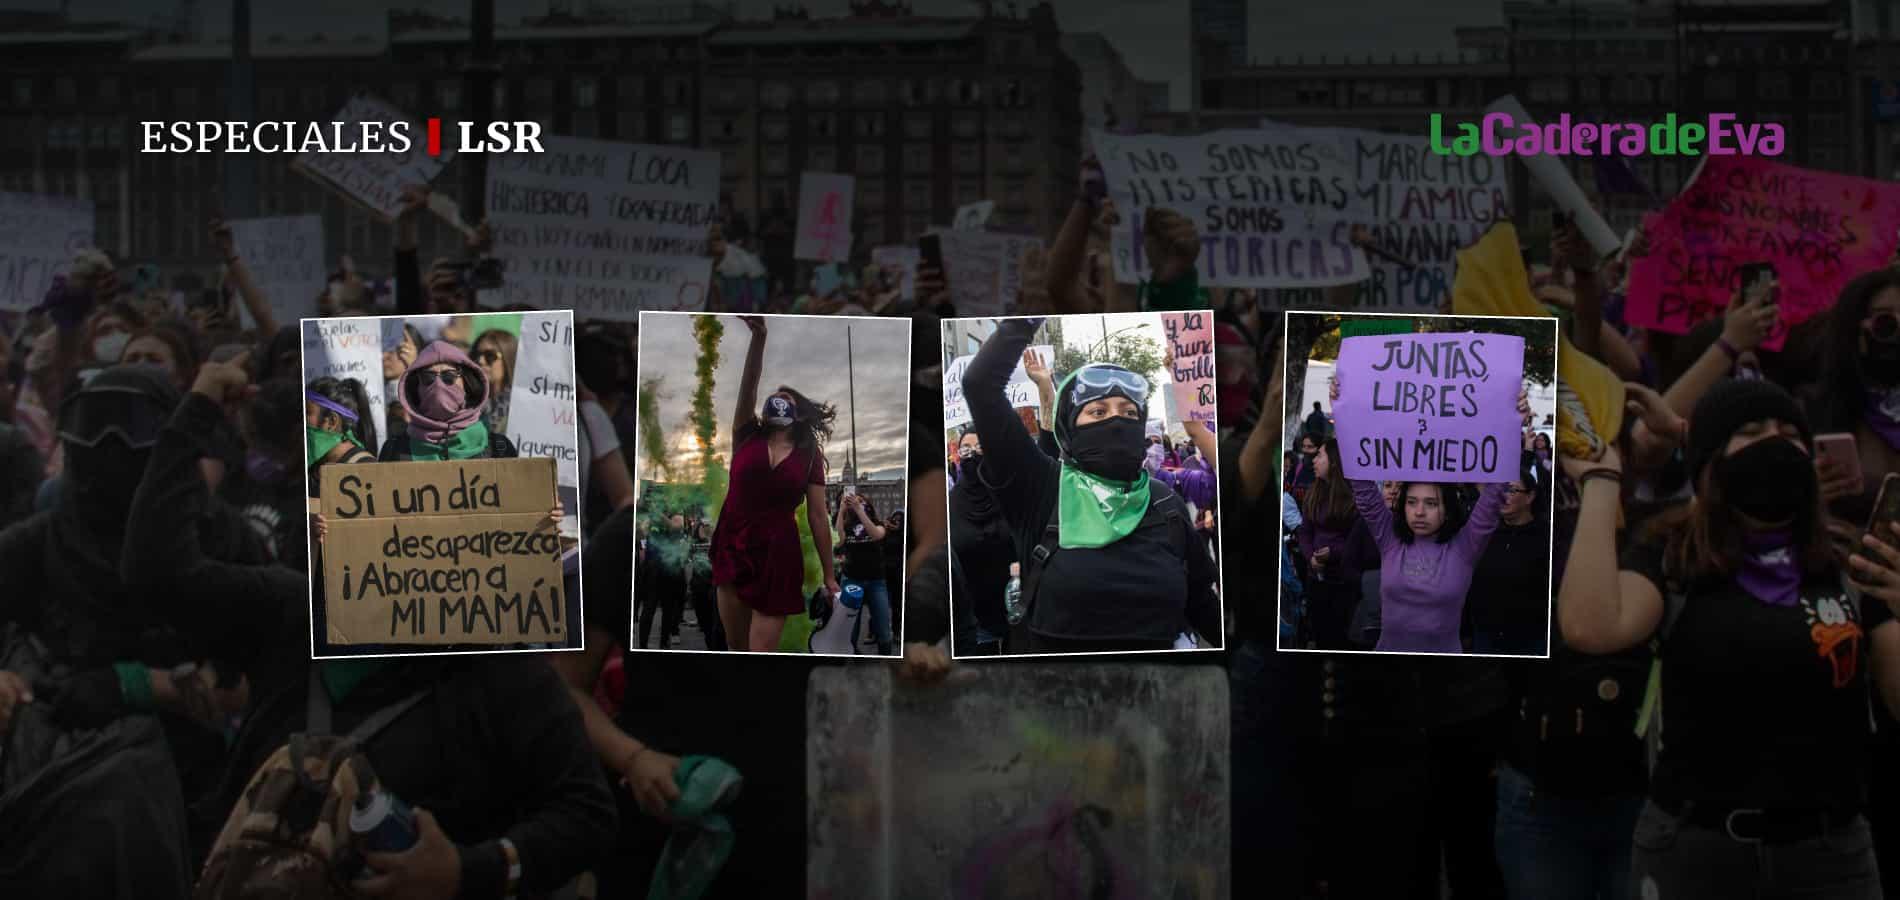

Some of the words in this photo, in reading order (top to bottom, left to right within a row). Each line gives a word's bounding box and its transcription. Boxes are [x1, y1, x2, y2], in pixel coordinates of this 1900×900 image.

[627, 151, 693, 190] LOCA
[1207, 142, 1321, 174] SOMOS
[1206, 203, 1285, 233] SOMOS
[1371, 339, 1490, 383] JUNTAS,
[1372, 381, 1479, 418] LIBRES
[1357, 436, 1403, 470] SIN
[1412, 434, 1499, 473] MIEDO
[336, 474, 376, 518] Si
[392, 484, 441, 514] un
[448, 467, 501, 510] día
[486, 563, 508, 592] a
[390, 598, 426, 636] MI
[439, 576, 561, 635] MAMÁ!
